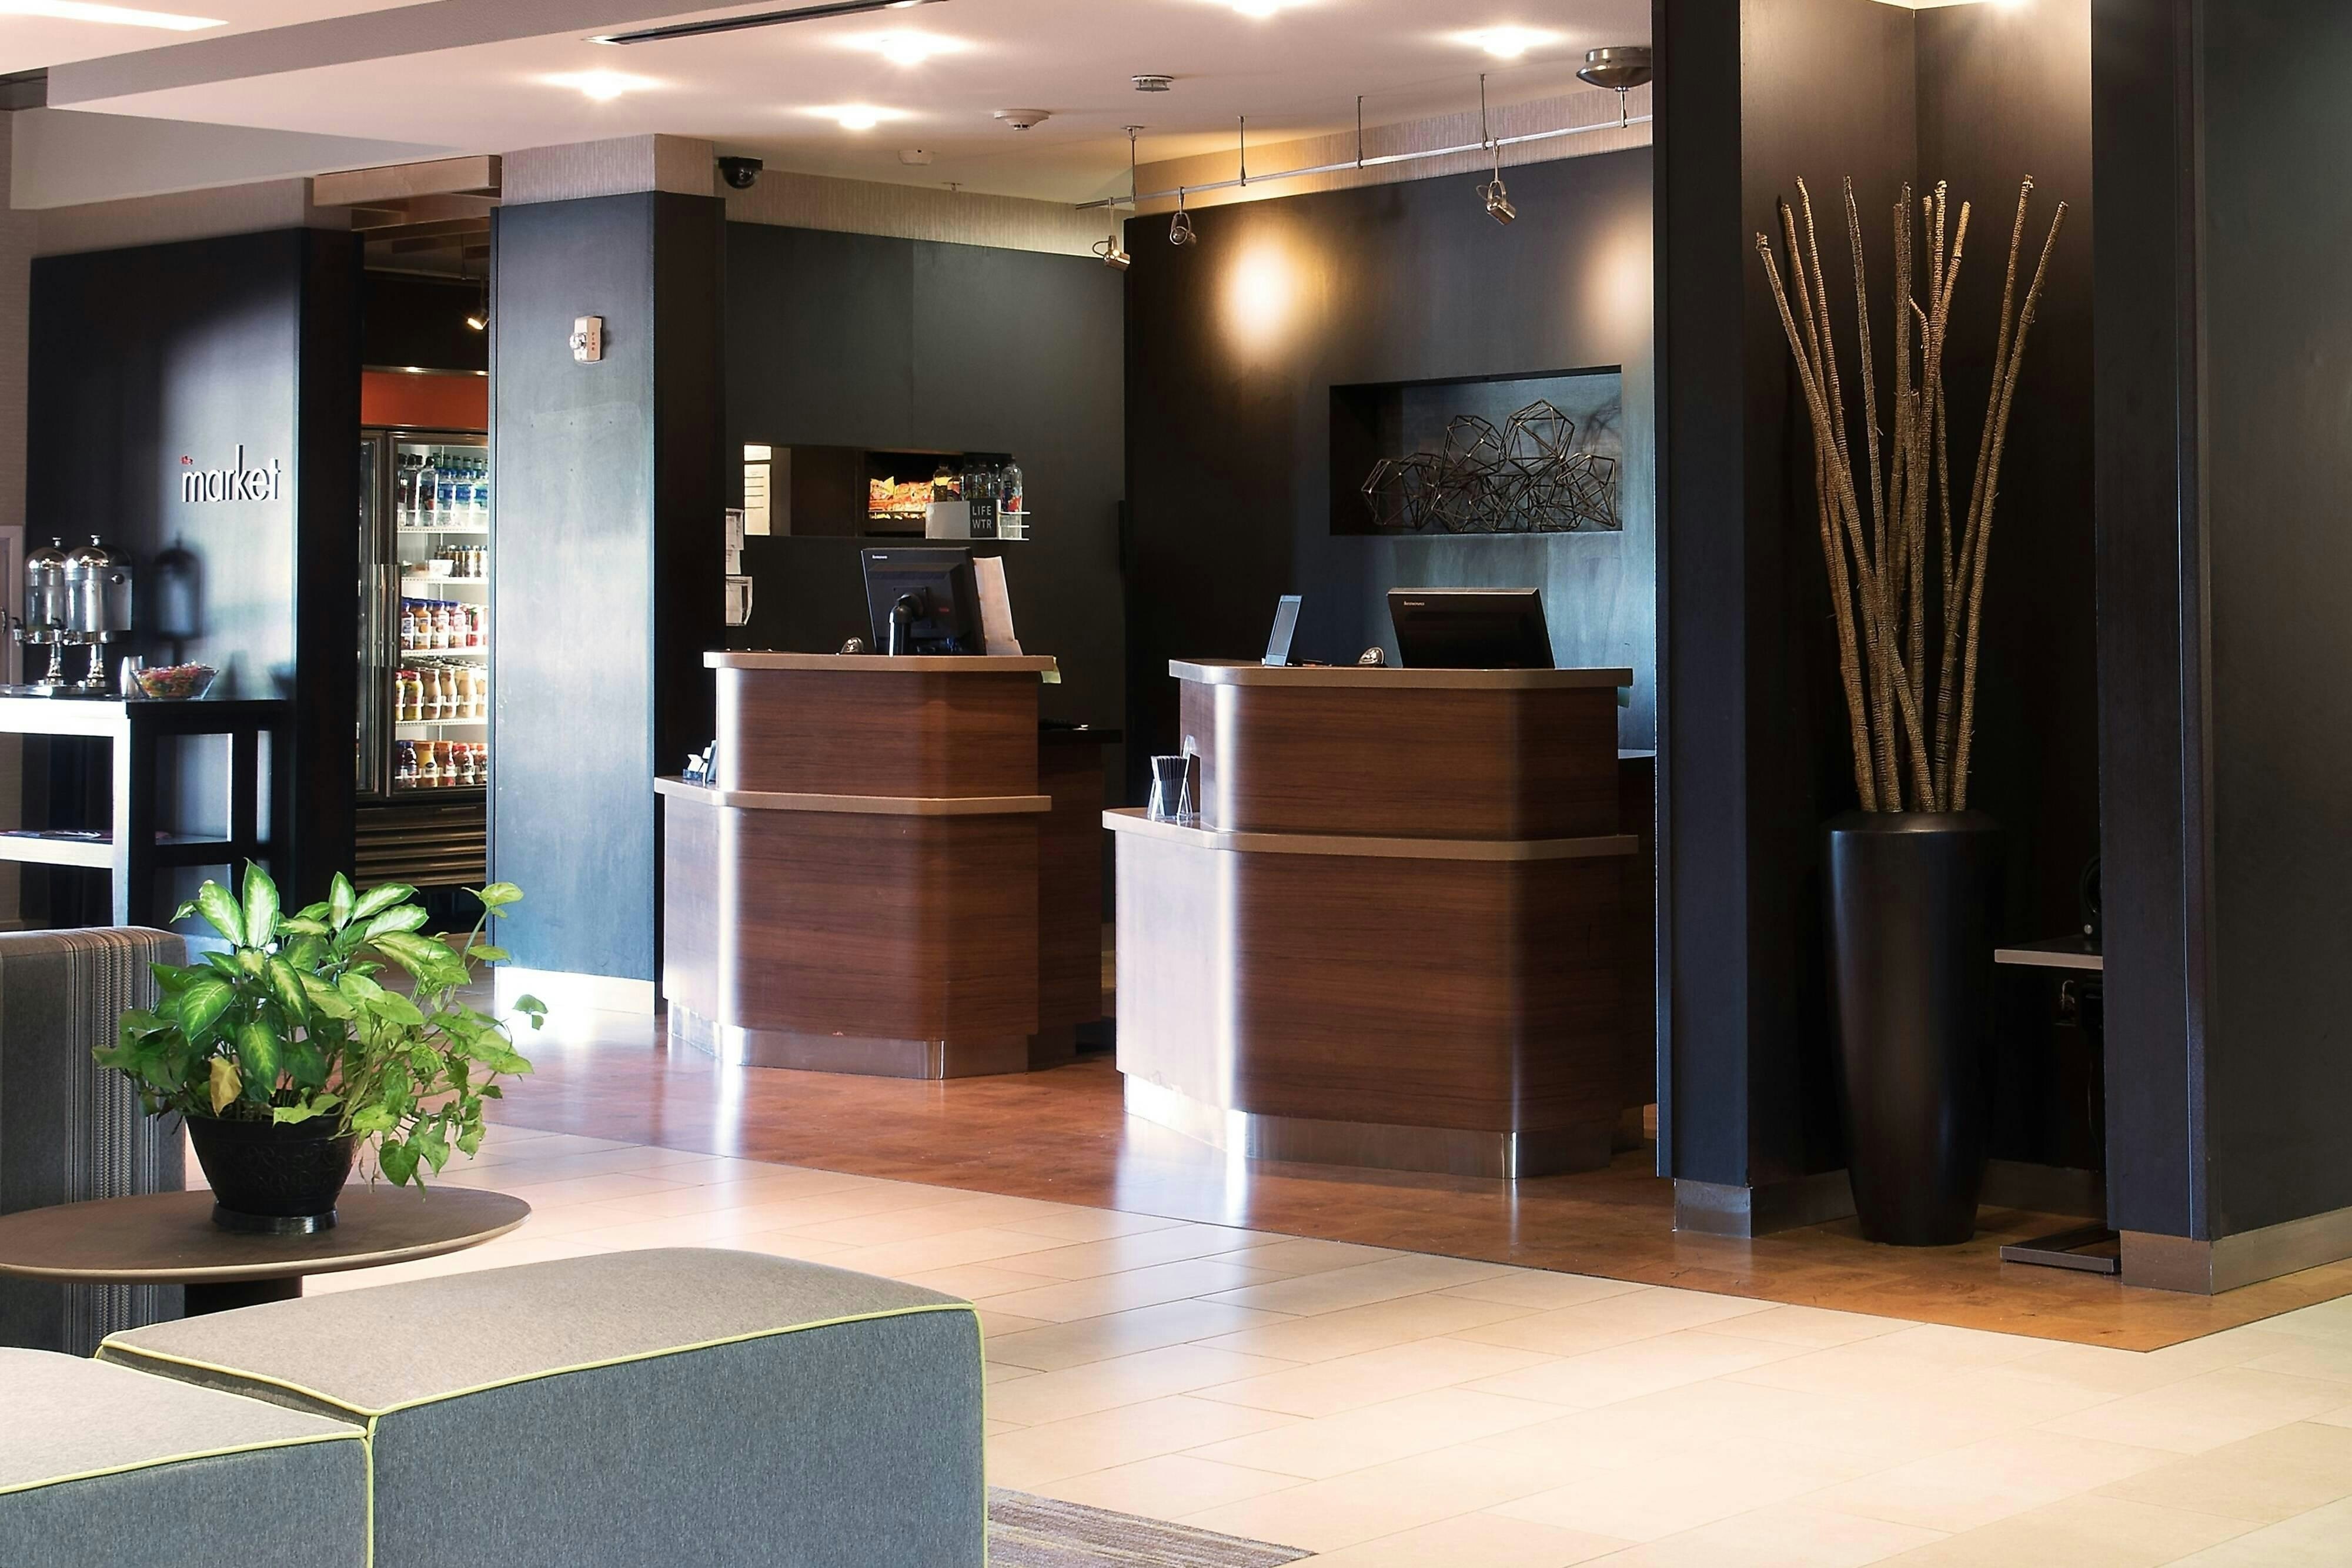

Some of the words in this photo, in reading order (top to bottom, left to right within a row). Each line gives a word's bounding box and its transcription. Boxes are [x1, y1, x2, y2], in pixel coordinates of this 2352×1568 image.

[182, 443, 280, 502] market
[972, 506, 991, 516] LIFE
[972, 519, 992, 529] WTR
